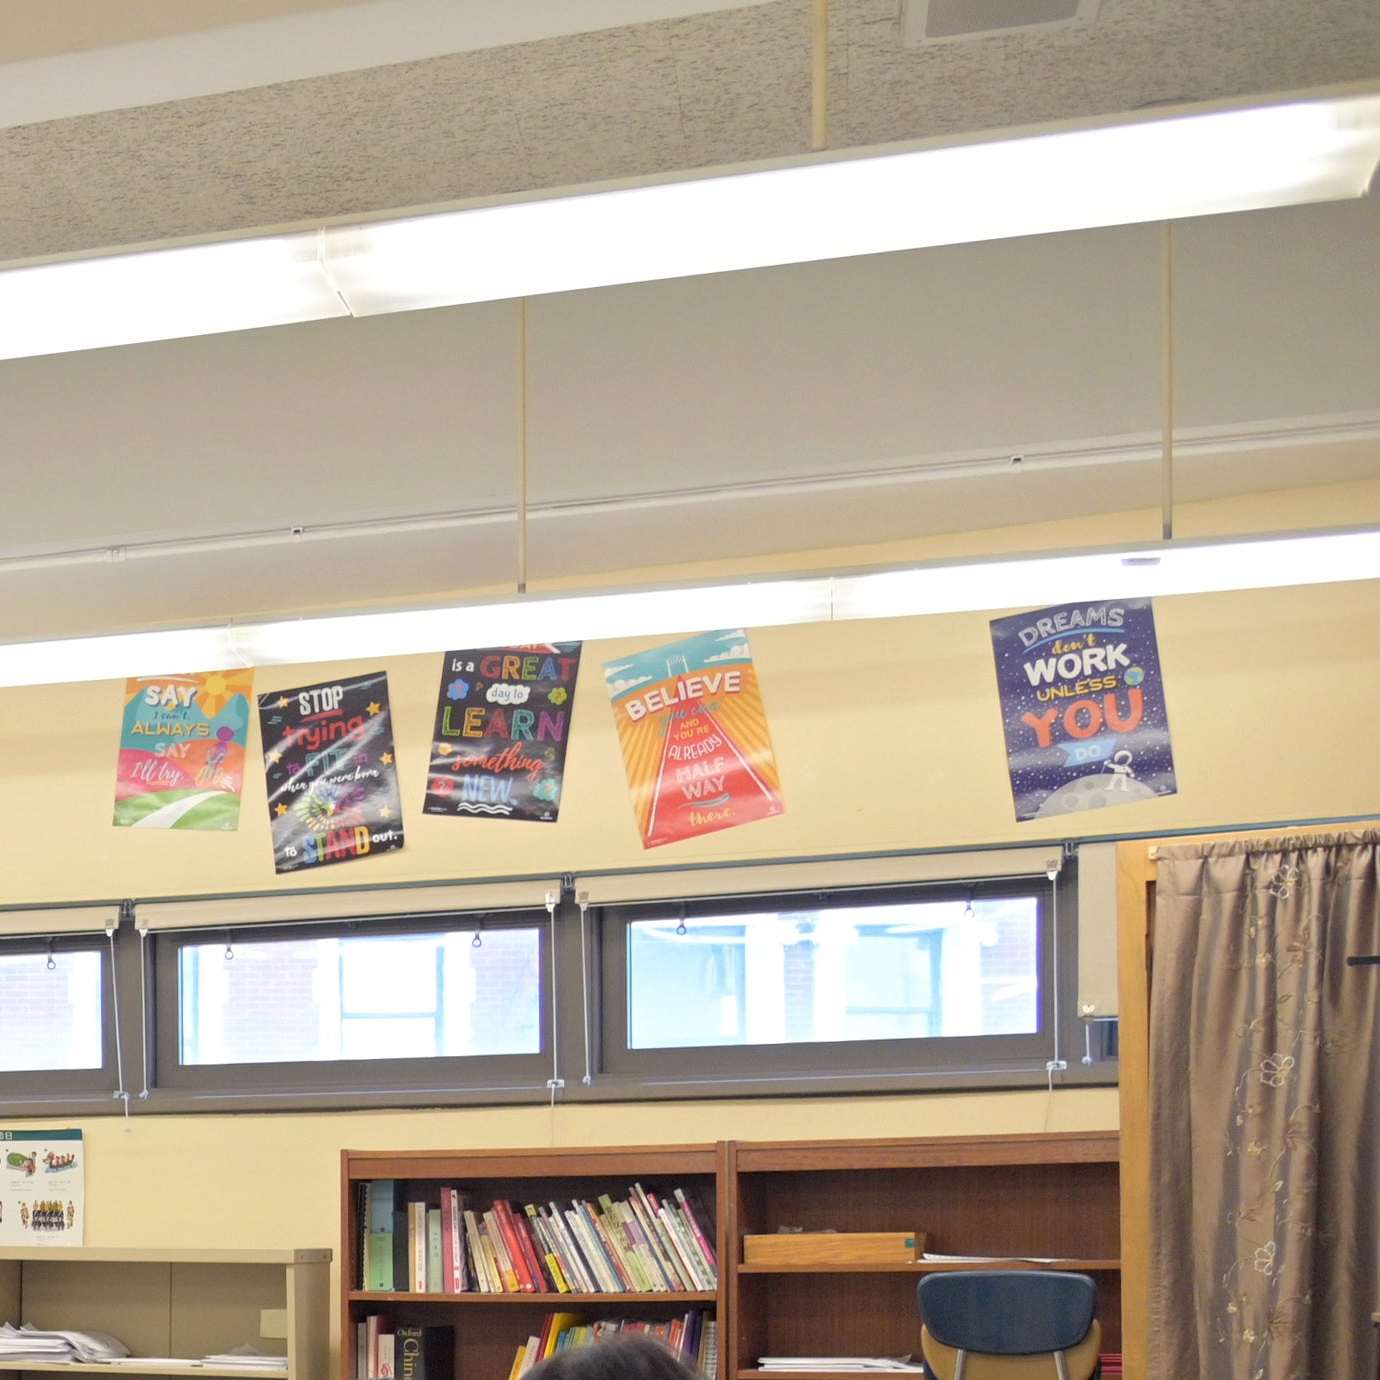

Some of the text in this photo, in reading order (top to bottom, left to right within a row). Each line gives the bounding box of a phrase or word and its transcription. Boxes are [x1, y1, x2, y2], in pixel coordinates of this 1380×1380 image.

[1017, 607, 1125, 648] DREAMS
[1051, 633, 1097, 655] don't
[452, 655, 577, 681] is a GREAT
[1023, 643, 1131, 687] WORK
[145, 684, 198, 707] SAY
[298, 685, 344, 715] STOP
[491, 687, 524, 700] day to
[625, 671, 742, 722] BELIEVE
[1036, 675, 1118, 702] UNLESS
[131, 721, 211, 737] ALWAYS
[442, 706, 565, 741] LEARN
[680, 718, 700, 730] AND
[1021, 689, 1144, 748] YOU
[282, 715, 365, 750] trying
[673, 725, 712, 742] YOU'RE
[154, 741, 191, 758] SAY
[667, 733, 723, 761] ALREADY
[305, 748, 351, 777] FIT
[451, 741, 545, 782] something
[675, 756, 726, 783] HALF
[280, 765, 380, 793] when you were born
[681, 776, 726, 800] WAY
[301, 825, 371, 864] STAND
[397, 1327, 423, 1337] Oxford
